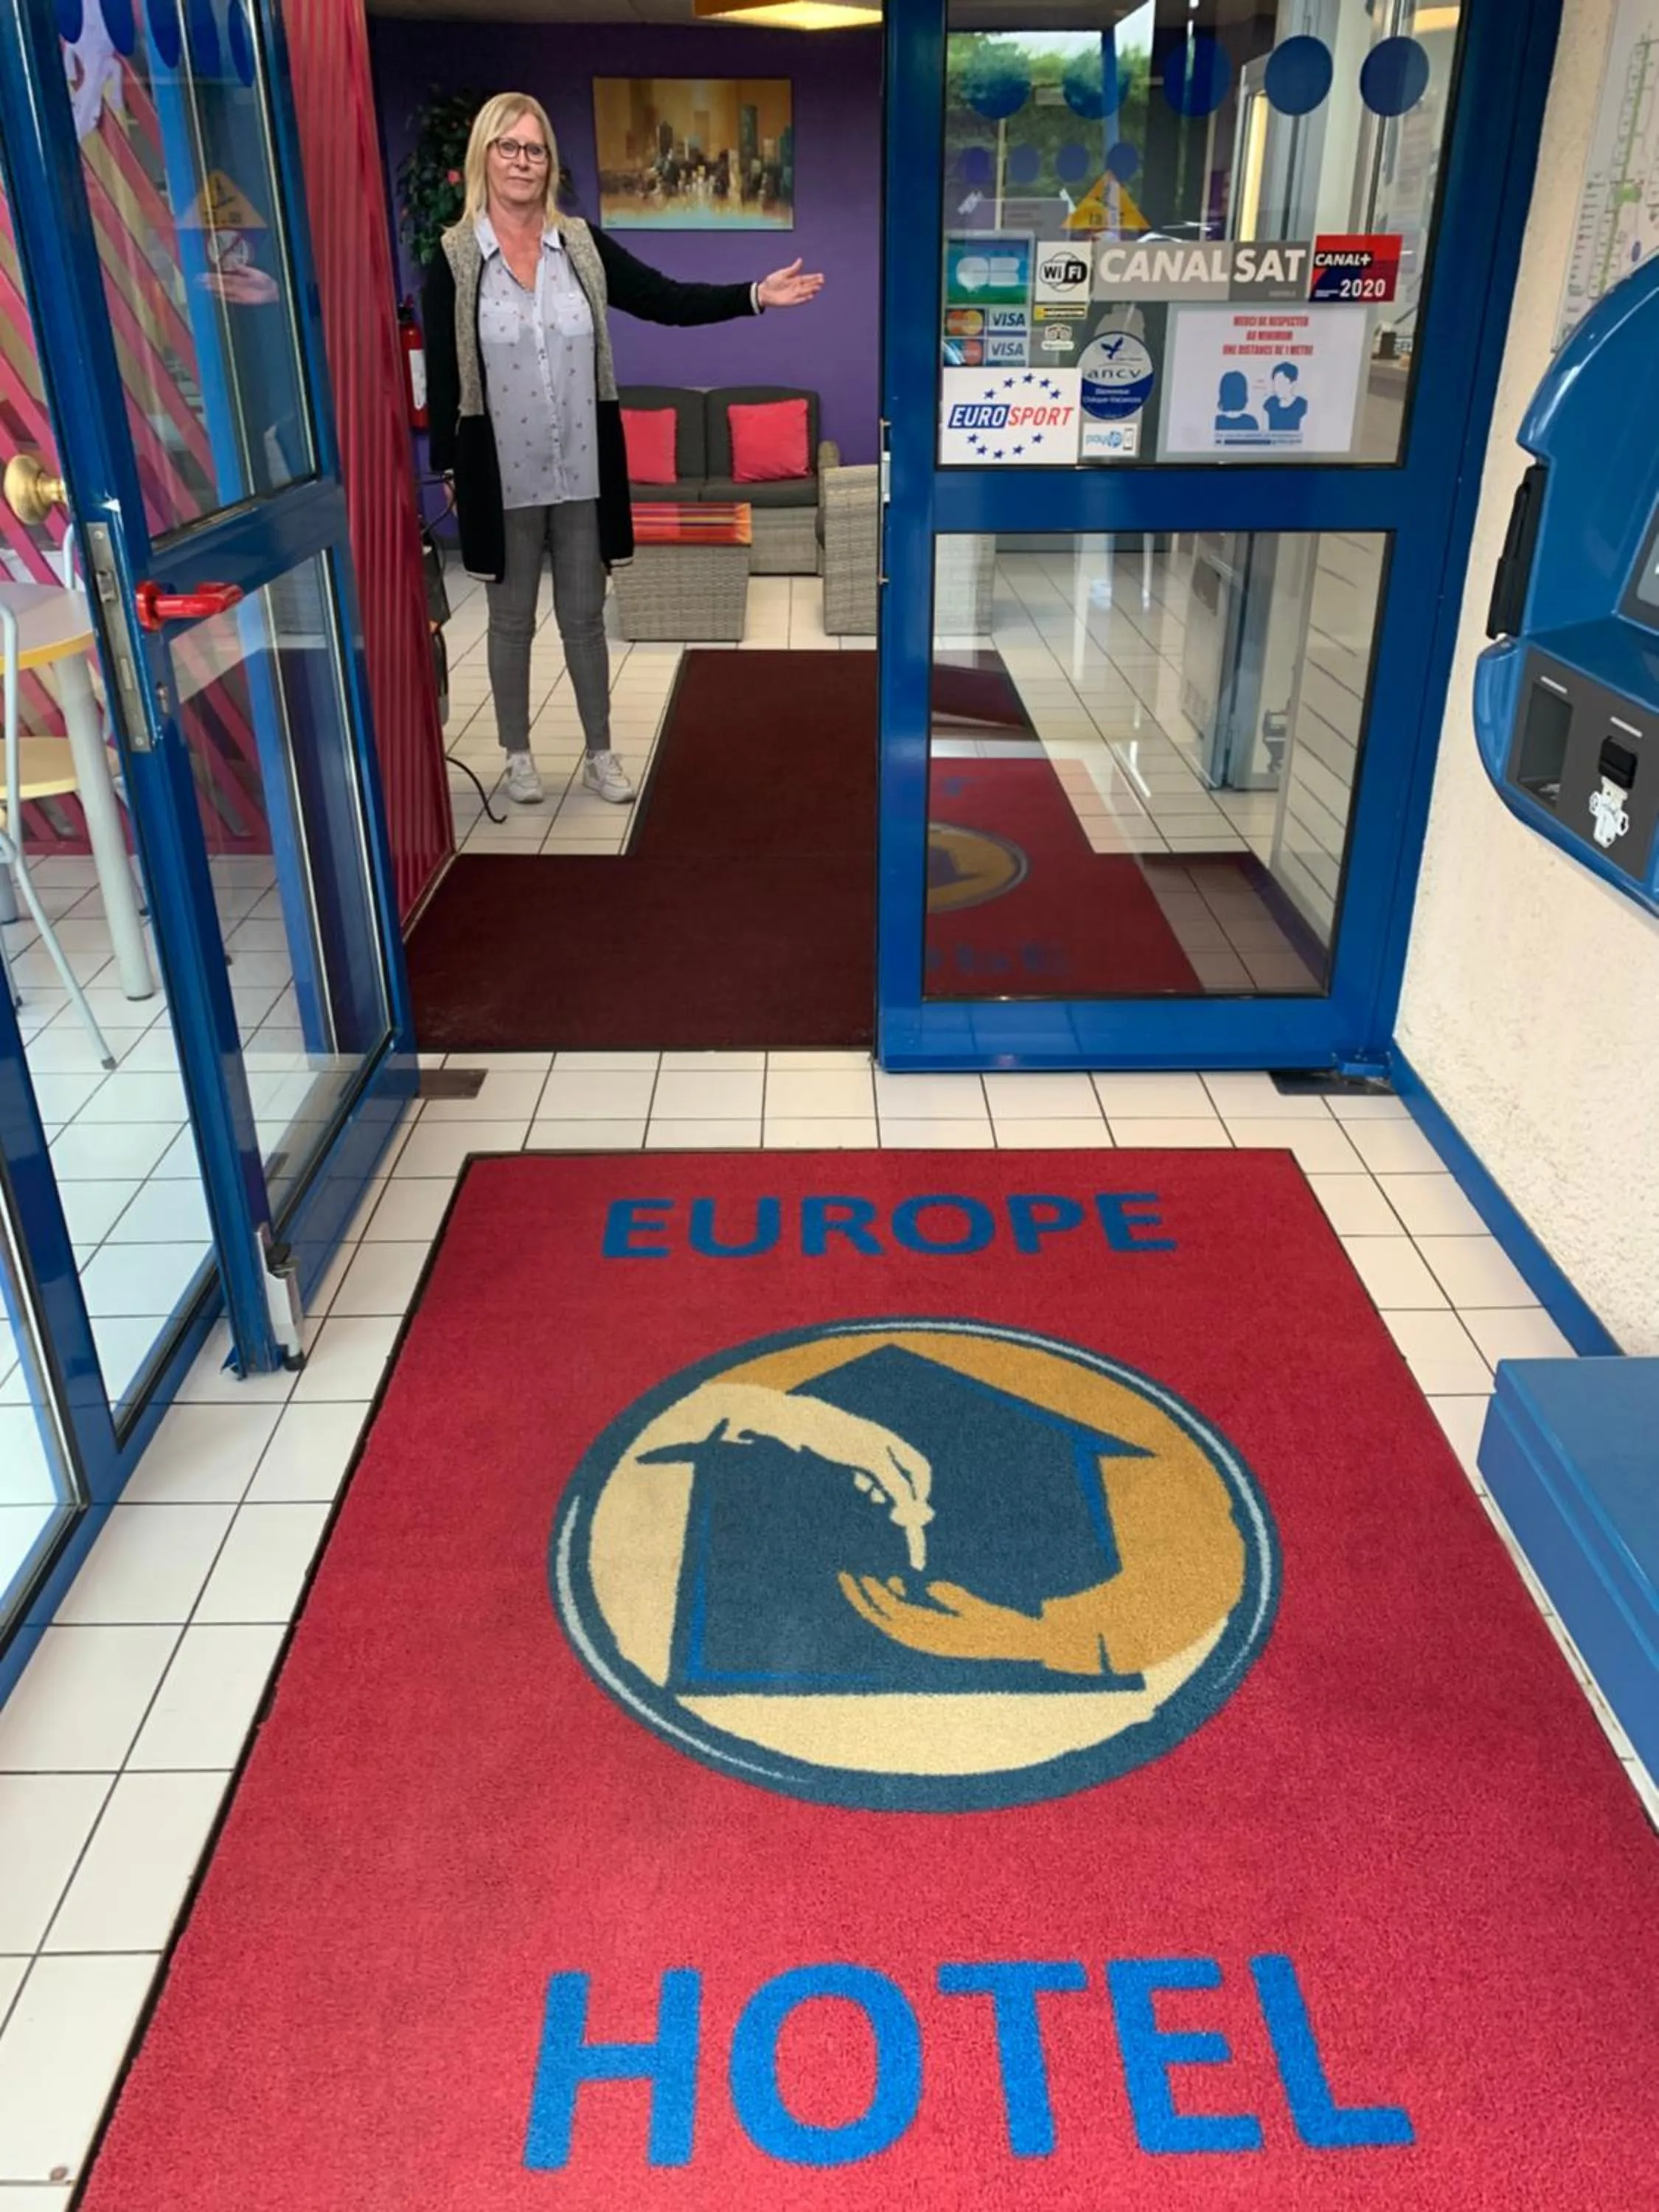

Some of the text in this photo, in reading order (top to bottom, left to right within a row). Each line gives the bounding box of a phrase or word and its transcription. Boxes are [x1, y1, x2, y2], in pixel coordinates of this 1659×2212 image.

[1315, 253, 1371, 266] CANAL+
[1339, 279, 1386, 298] 2020
[992, 313, 1026, 326] VISA
[992, 343, 1024, 355] VISA
[1087, 369, 1141, 378] ancv
[600, 1192, 1177, 1259] EUROPE
[522, 1953, 1415, 2170] HOTEL
